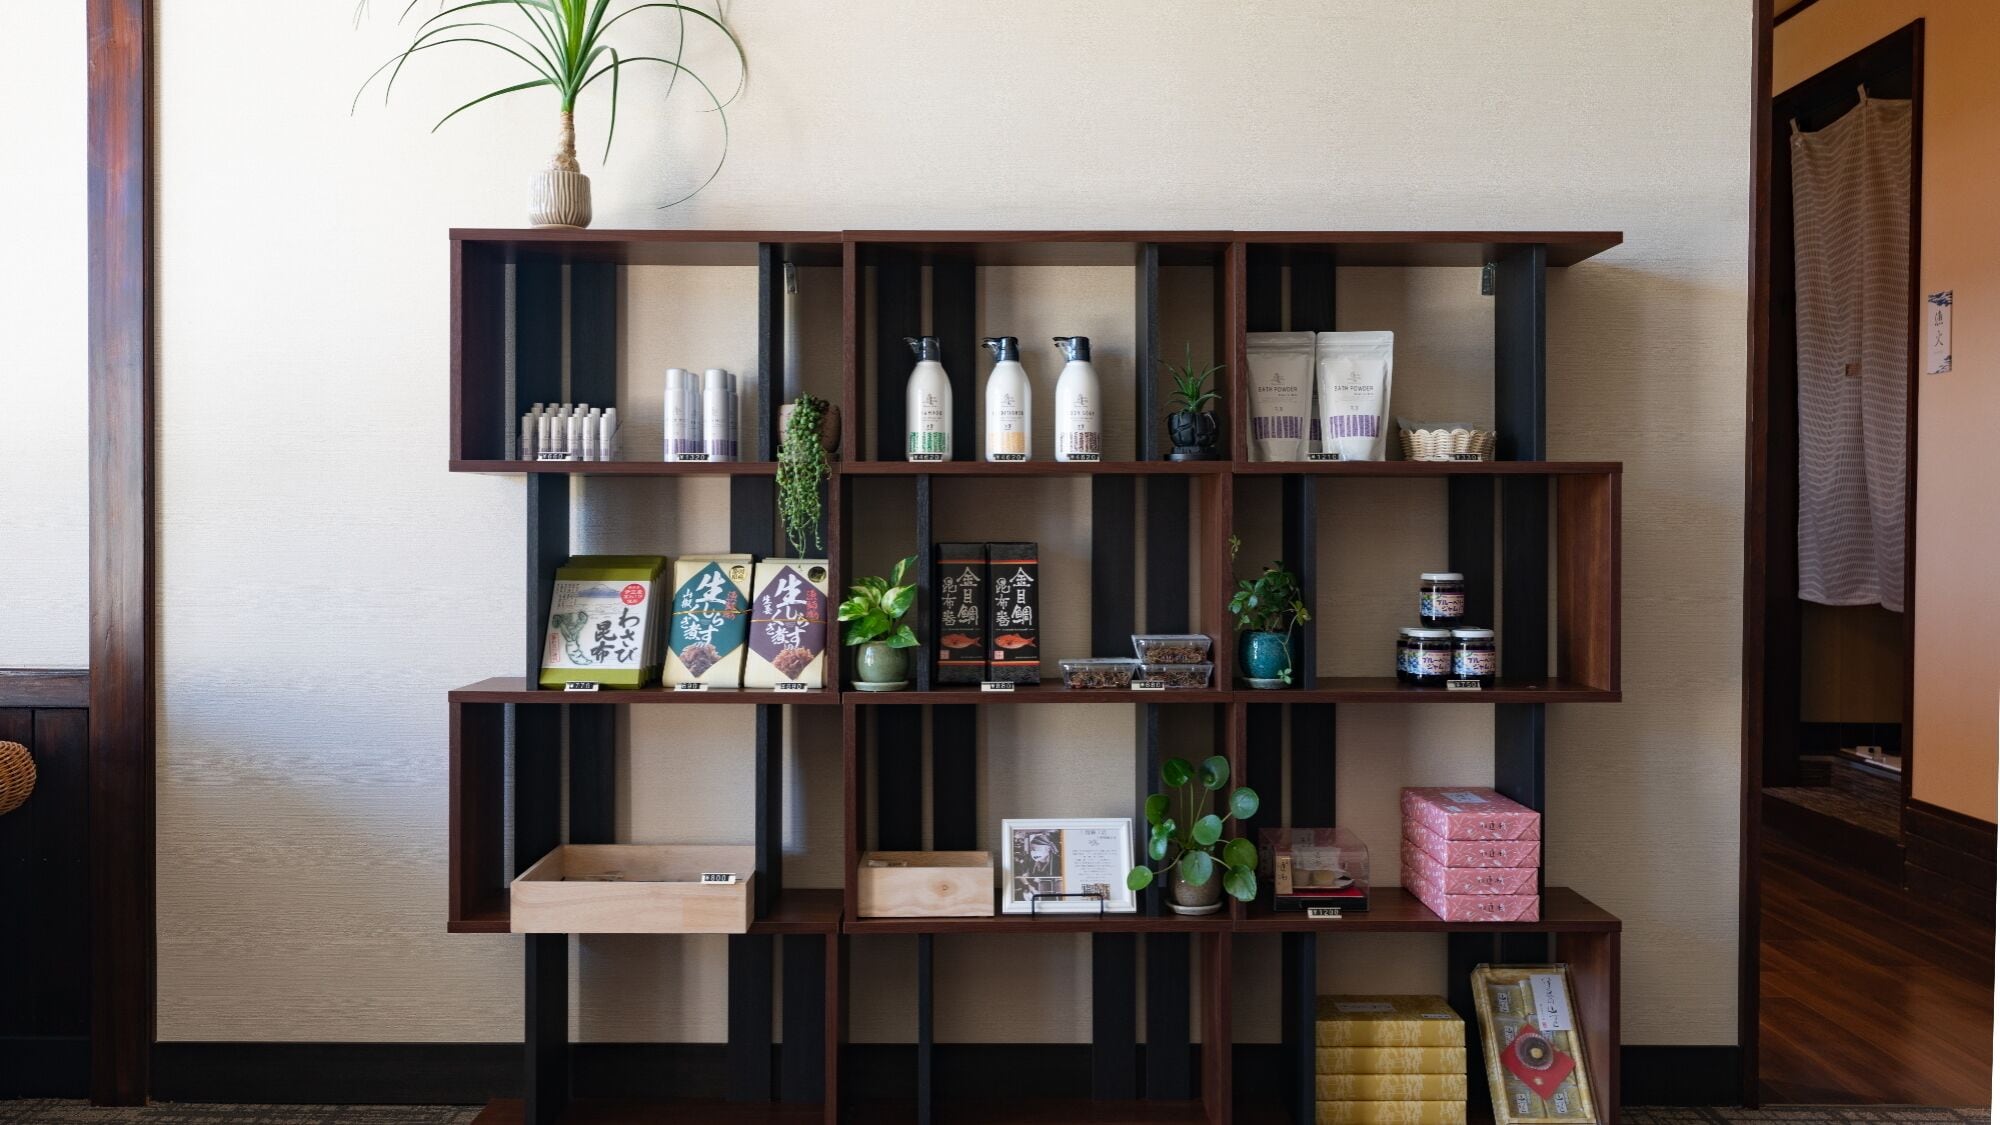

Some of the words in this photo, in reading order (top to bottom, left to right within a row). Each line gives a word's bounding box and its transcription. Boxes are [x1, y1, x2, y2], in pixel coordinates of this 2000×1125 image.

[941, 576, 957, 626] 昆布巻
[956, 566, 981, 625] 金目鯛
[994, 577, 1011, 627] 昆布巻
[1009, 566, 1035, 626] 金目鯛
[590, 620, 617, 663] 昆布
[615, 607, 640, 663] わさび
